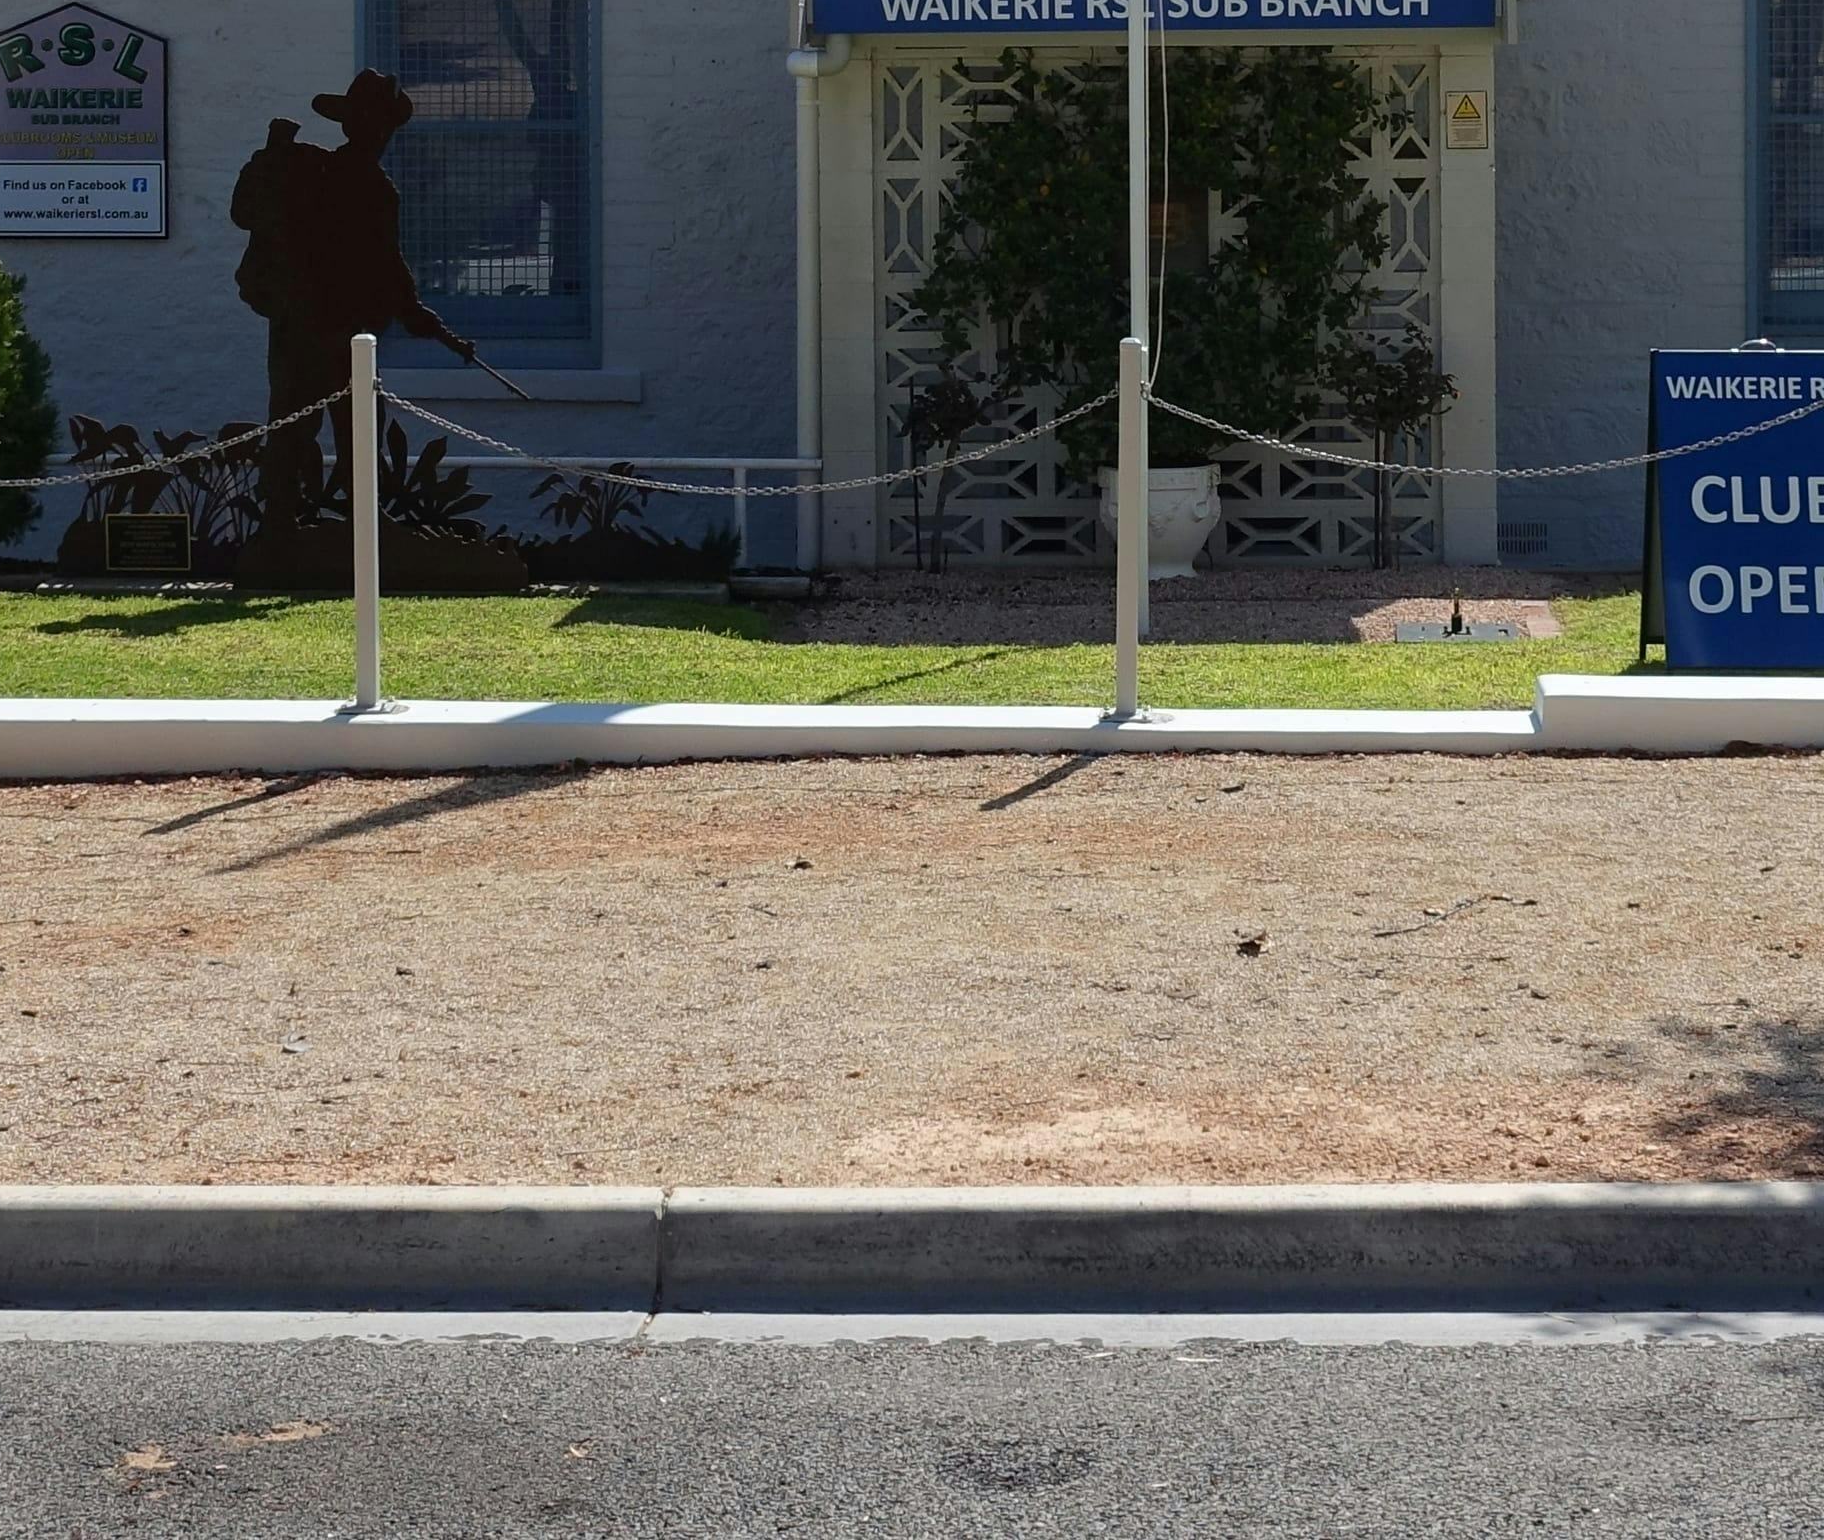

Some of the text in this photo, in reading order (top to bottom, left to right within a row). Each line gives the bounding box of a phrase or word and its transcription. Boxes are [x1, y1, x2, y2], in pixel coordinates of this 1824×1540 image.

[5, 87, 144, 110] WAIKERIE
[30, 113, 121, 126] SUB BRANCH
[95, 131, 158, 145] MUSEUM
[3, 179, 30, 192] Find
[32, 182, 47, 192] us
[49, 182, 65, 192] on
[68, 179, 127, 192] Facebook
[61, 195, 90, 205] or at
[3, 208, 149, 220] www.waikeriersl.com.au
[1666, 375, 1804, 400] WAIKERIE
